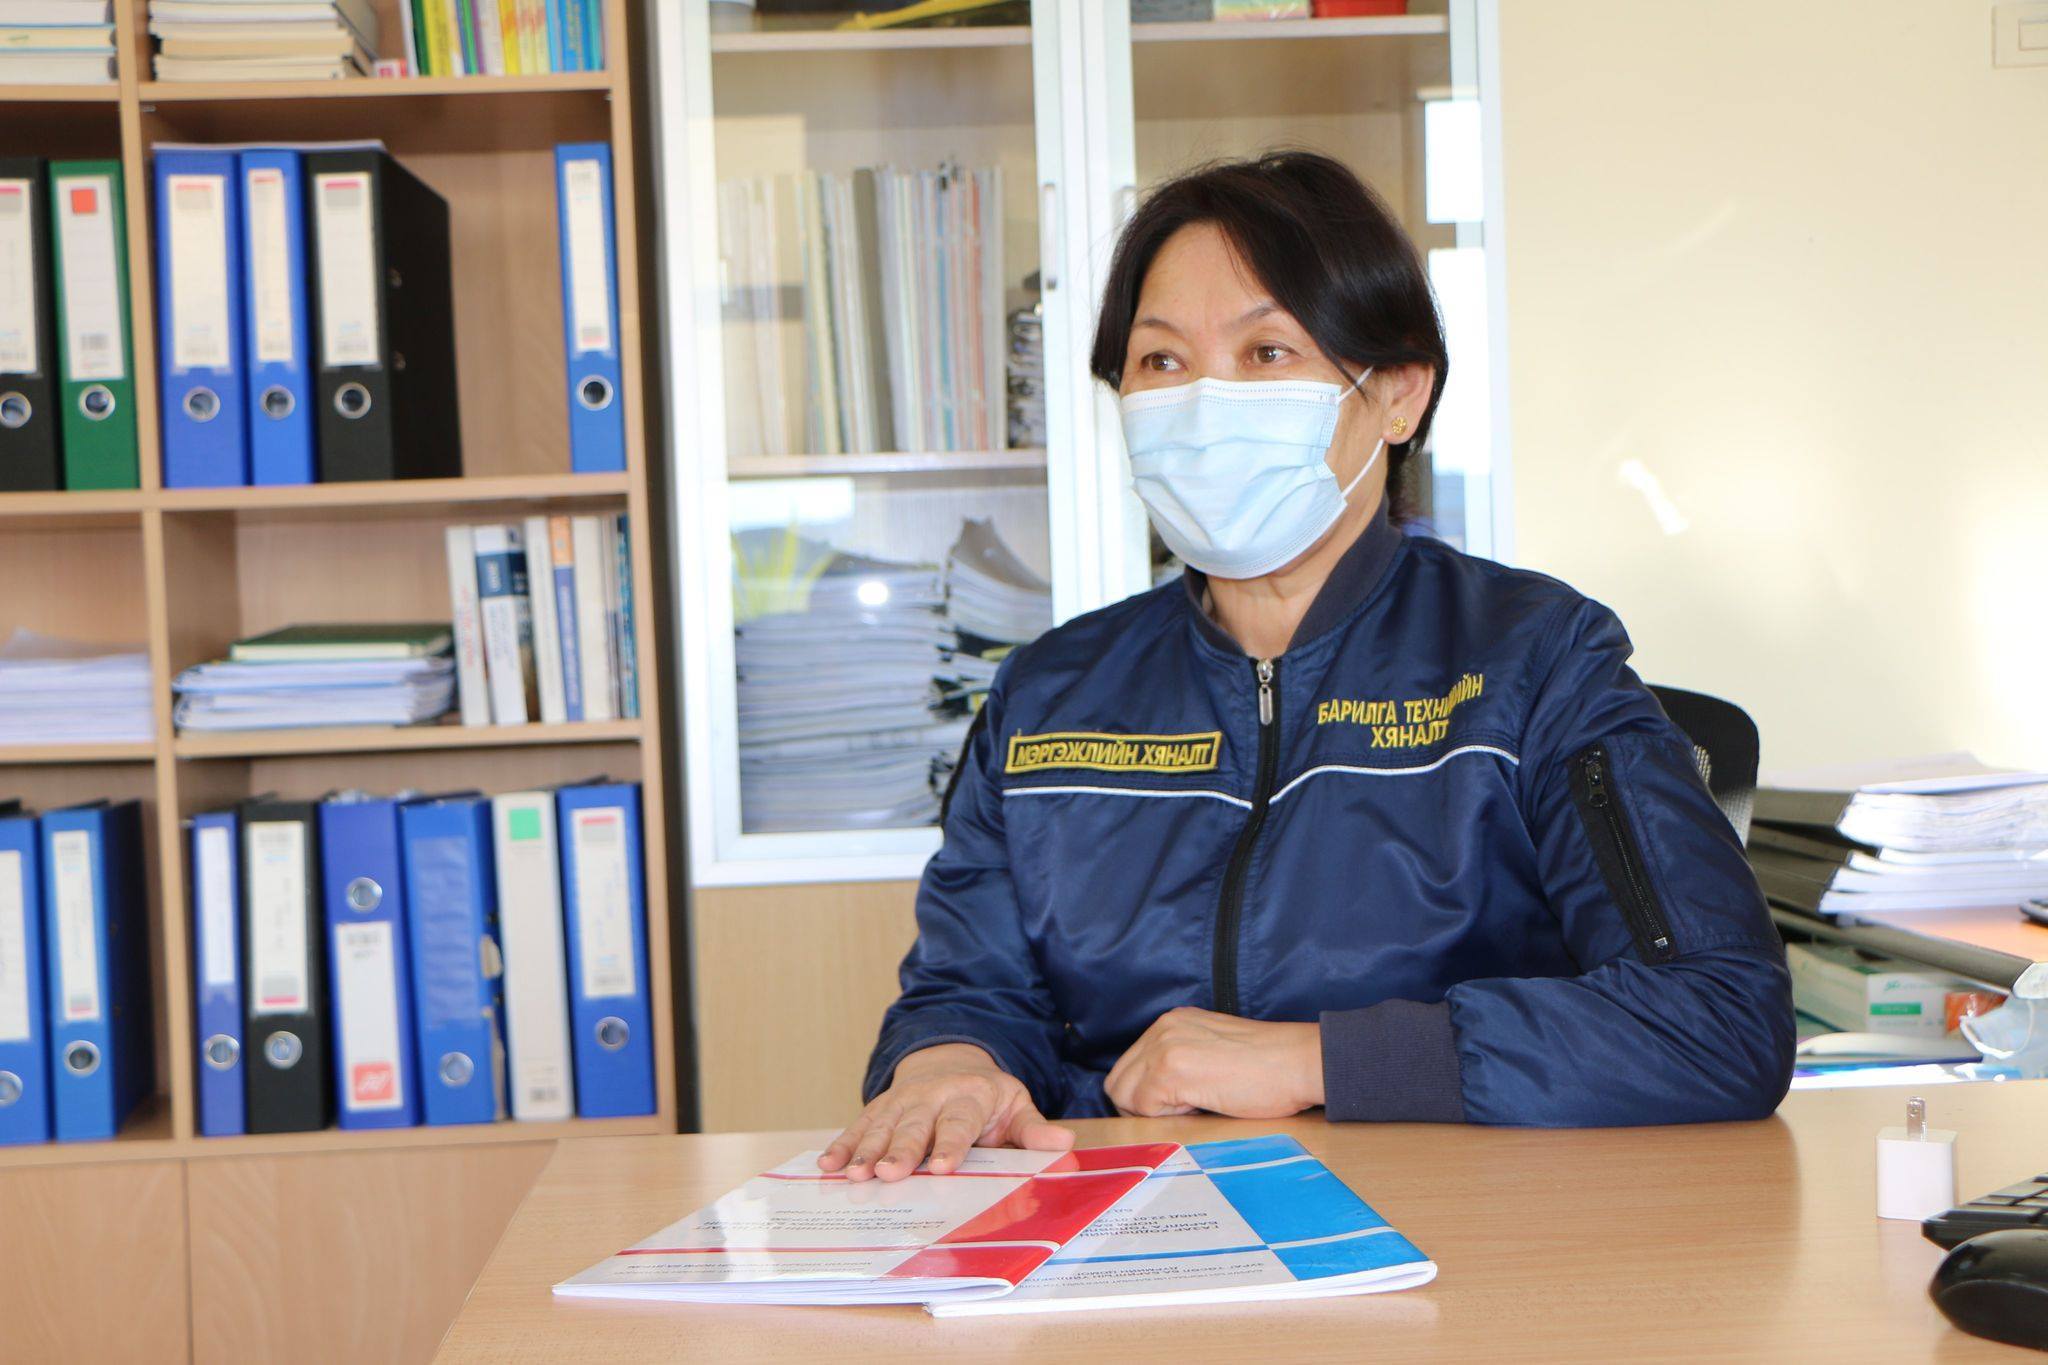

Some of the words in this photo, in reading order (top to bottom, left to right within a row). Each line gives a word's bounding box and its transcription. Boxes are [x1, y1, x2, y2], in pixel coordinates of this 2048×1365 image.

[1317, 698, 1398, 725] БАРИЛГА
[1370, 719, 1449, 749] ХЯНАЛТ
[1015, 739, 1139, 766] МЭРГЭЖЛИЙН
[1141, 743, 1212, 766] ХЯНАЛТ
